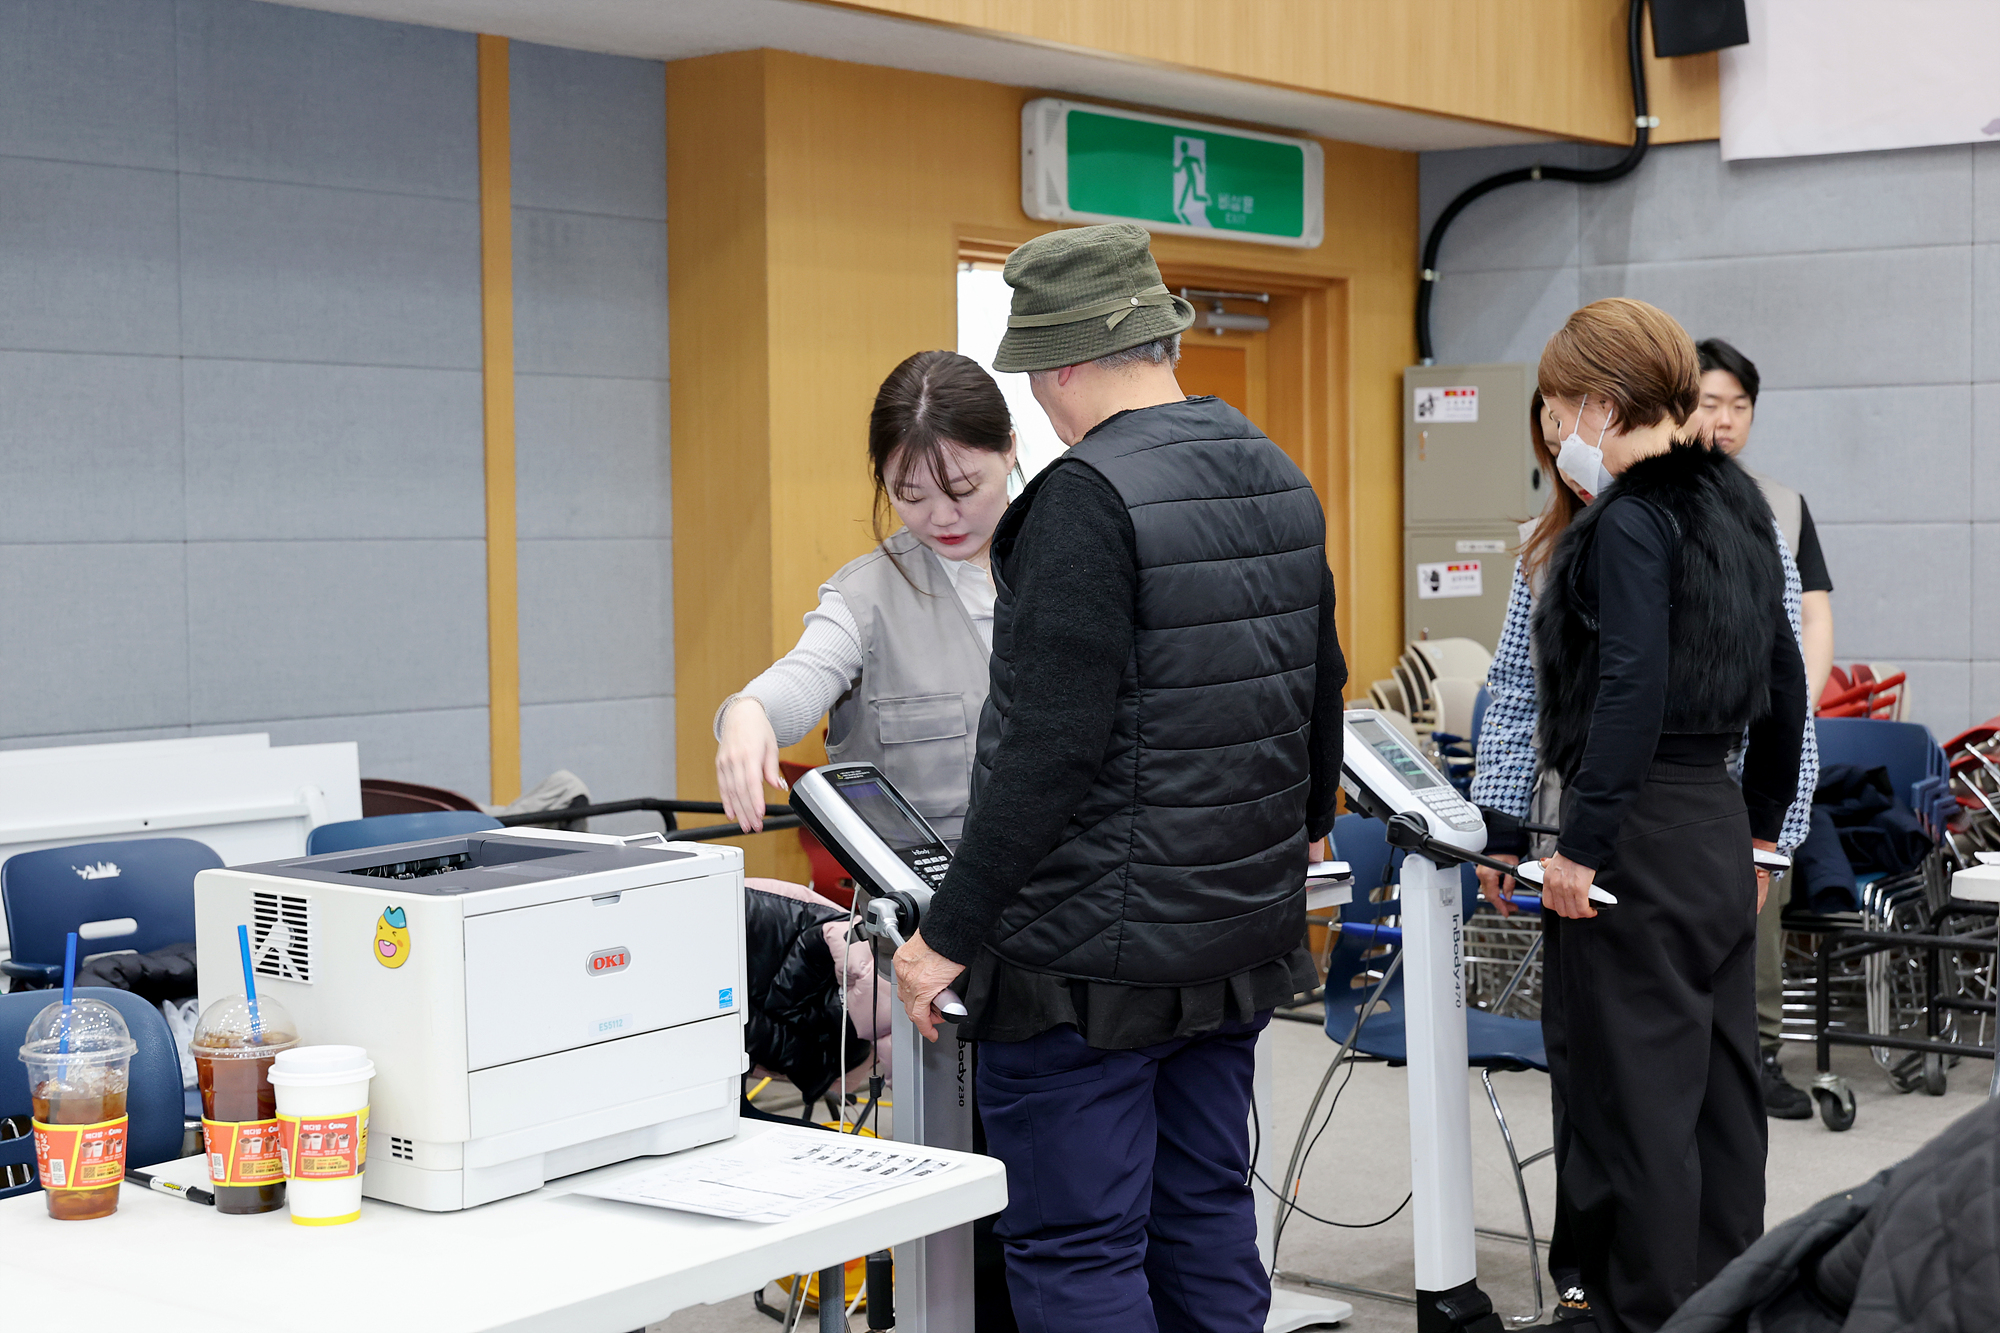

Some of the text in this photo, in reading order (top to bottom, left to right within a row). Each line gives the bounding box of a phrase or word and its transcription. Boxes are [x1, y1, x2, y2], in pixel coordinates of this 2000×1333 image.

[593, 953, 625, 970] OKI
[1452, 914, 1462, 980] InBody
[599, 1018, 623, 1031] ES5112
[956, 1040, 967, 1084] Body
